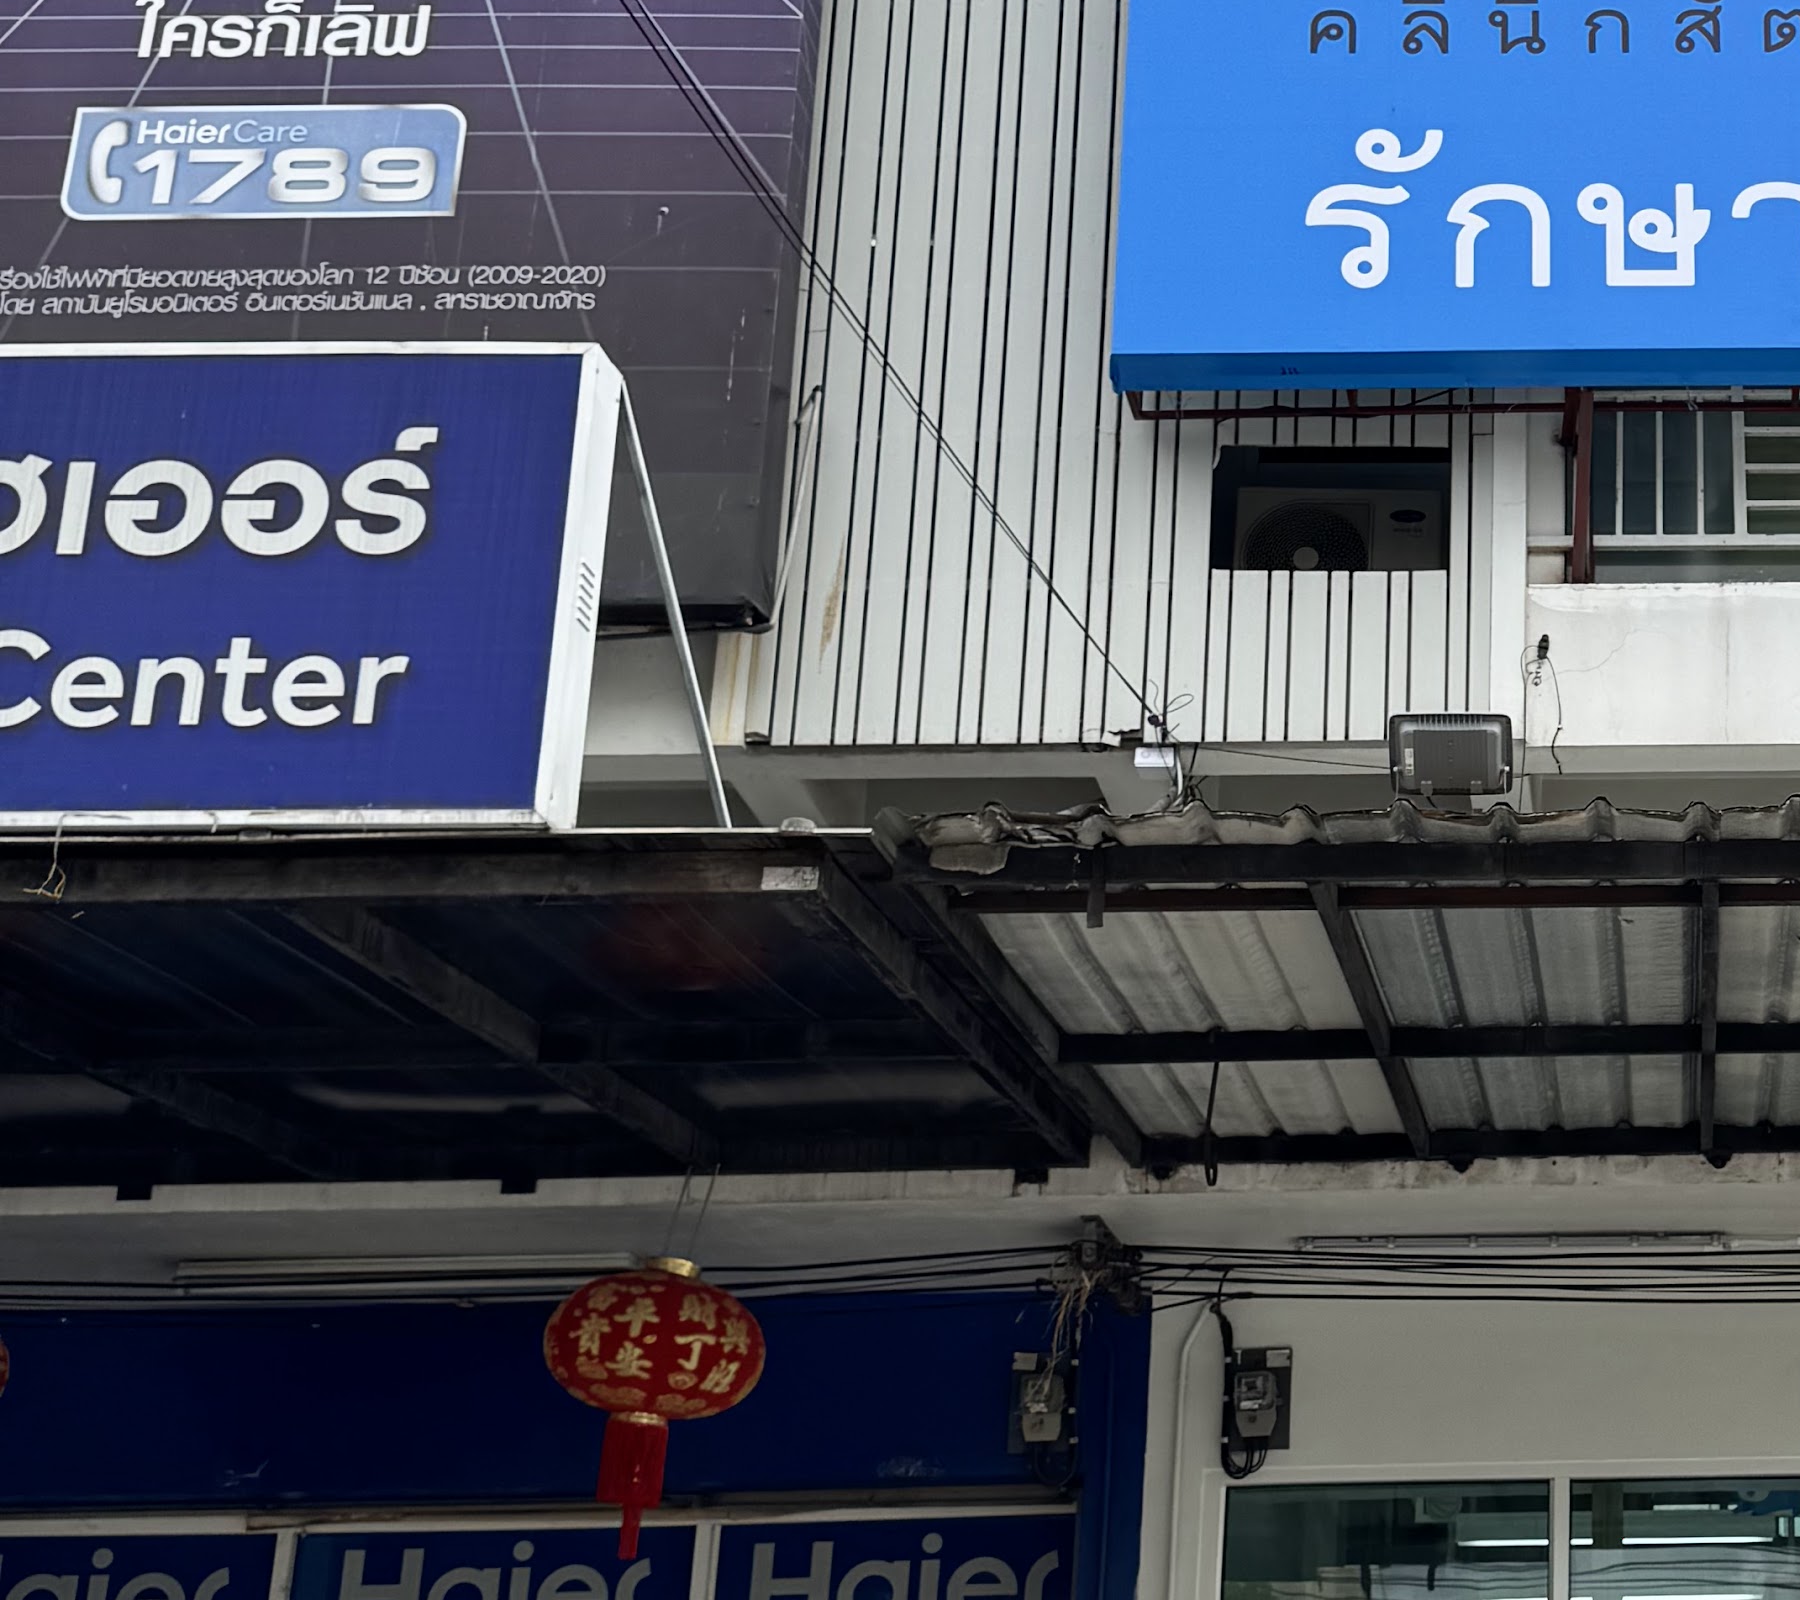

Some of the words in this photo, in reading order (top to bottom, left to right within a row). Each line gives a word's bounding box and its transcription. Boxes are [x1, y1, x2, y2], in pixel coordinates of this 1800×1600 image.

[132, 148, 436, 205] 1789
[365, 265, 391, 285] 12
[467, 264, 607, 288] (2009-2020)
